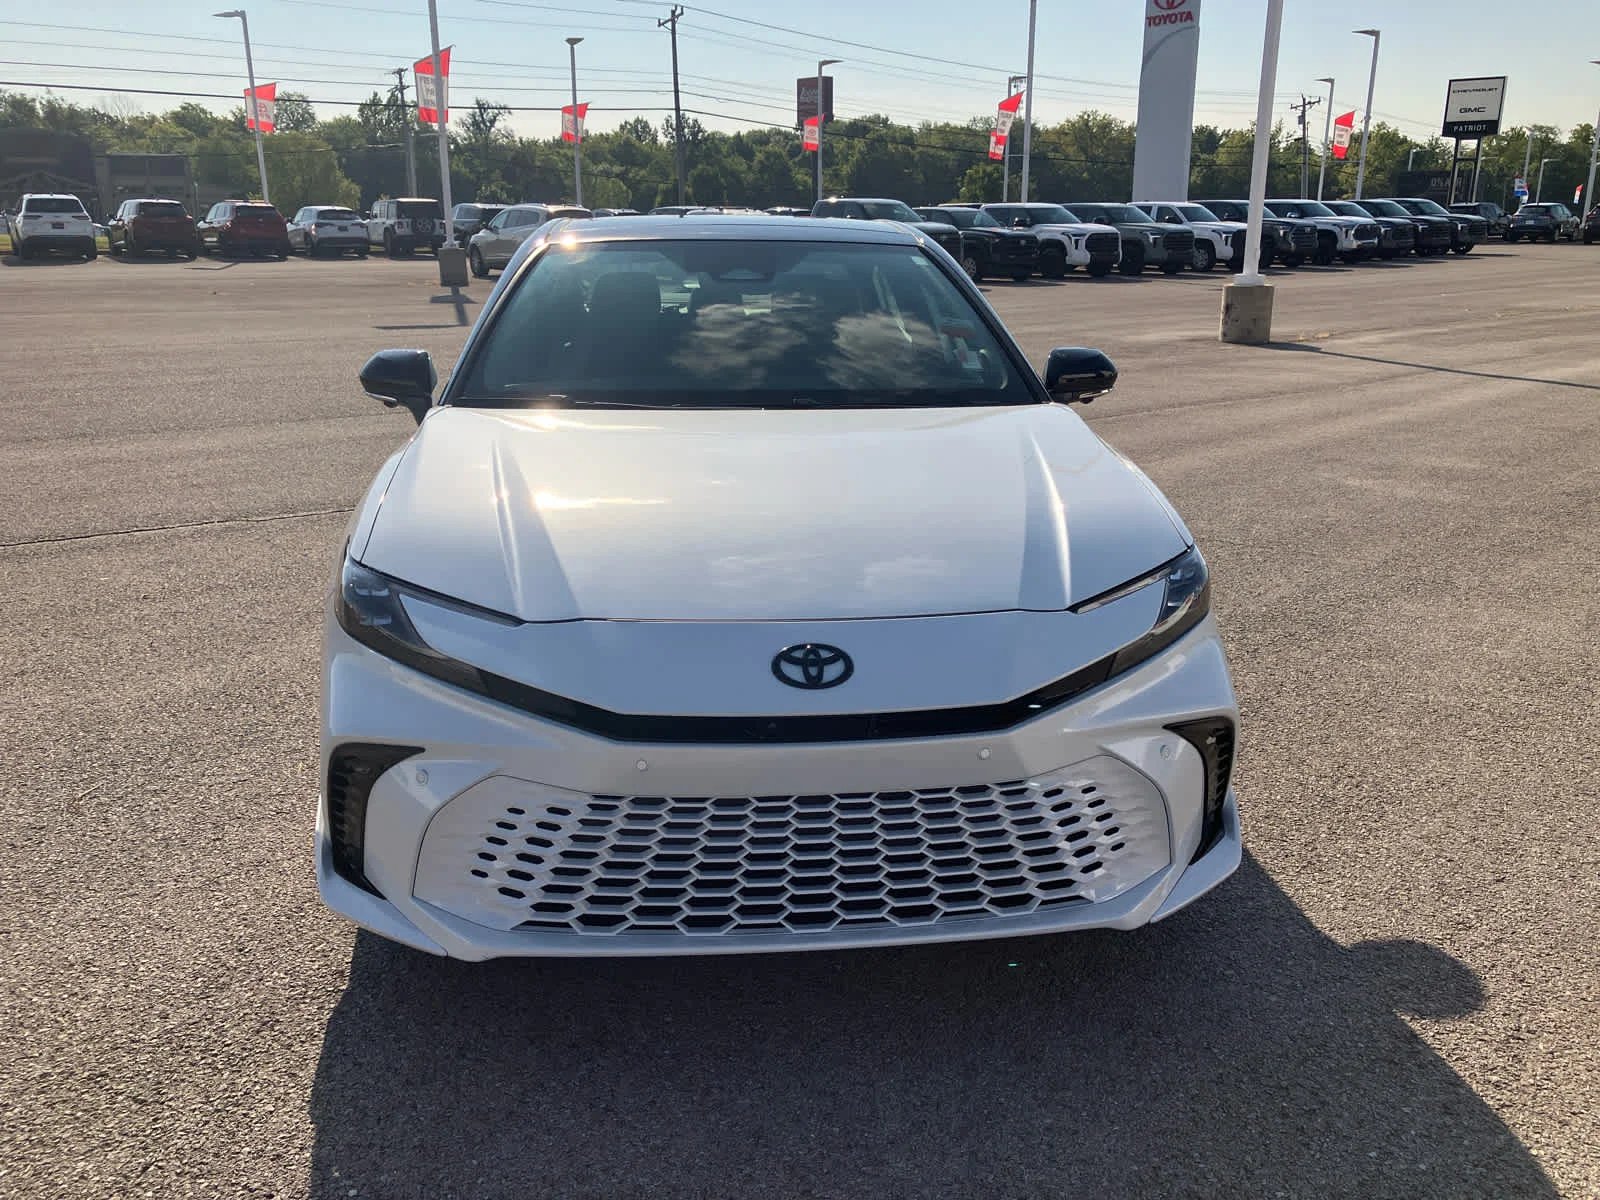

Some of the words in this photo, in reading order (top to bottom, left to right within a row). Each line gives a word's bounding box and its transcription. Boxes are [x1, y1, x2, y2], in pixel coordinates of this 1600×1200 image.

[1146, 11, 1193, 27] TOYOTA
[1459, 106, 1487, 114] GMC
[1453, 124, 1487, 132] PATRIOT
